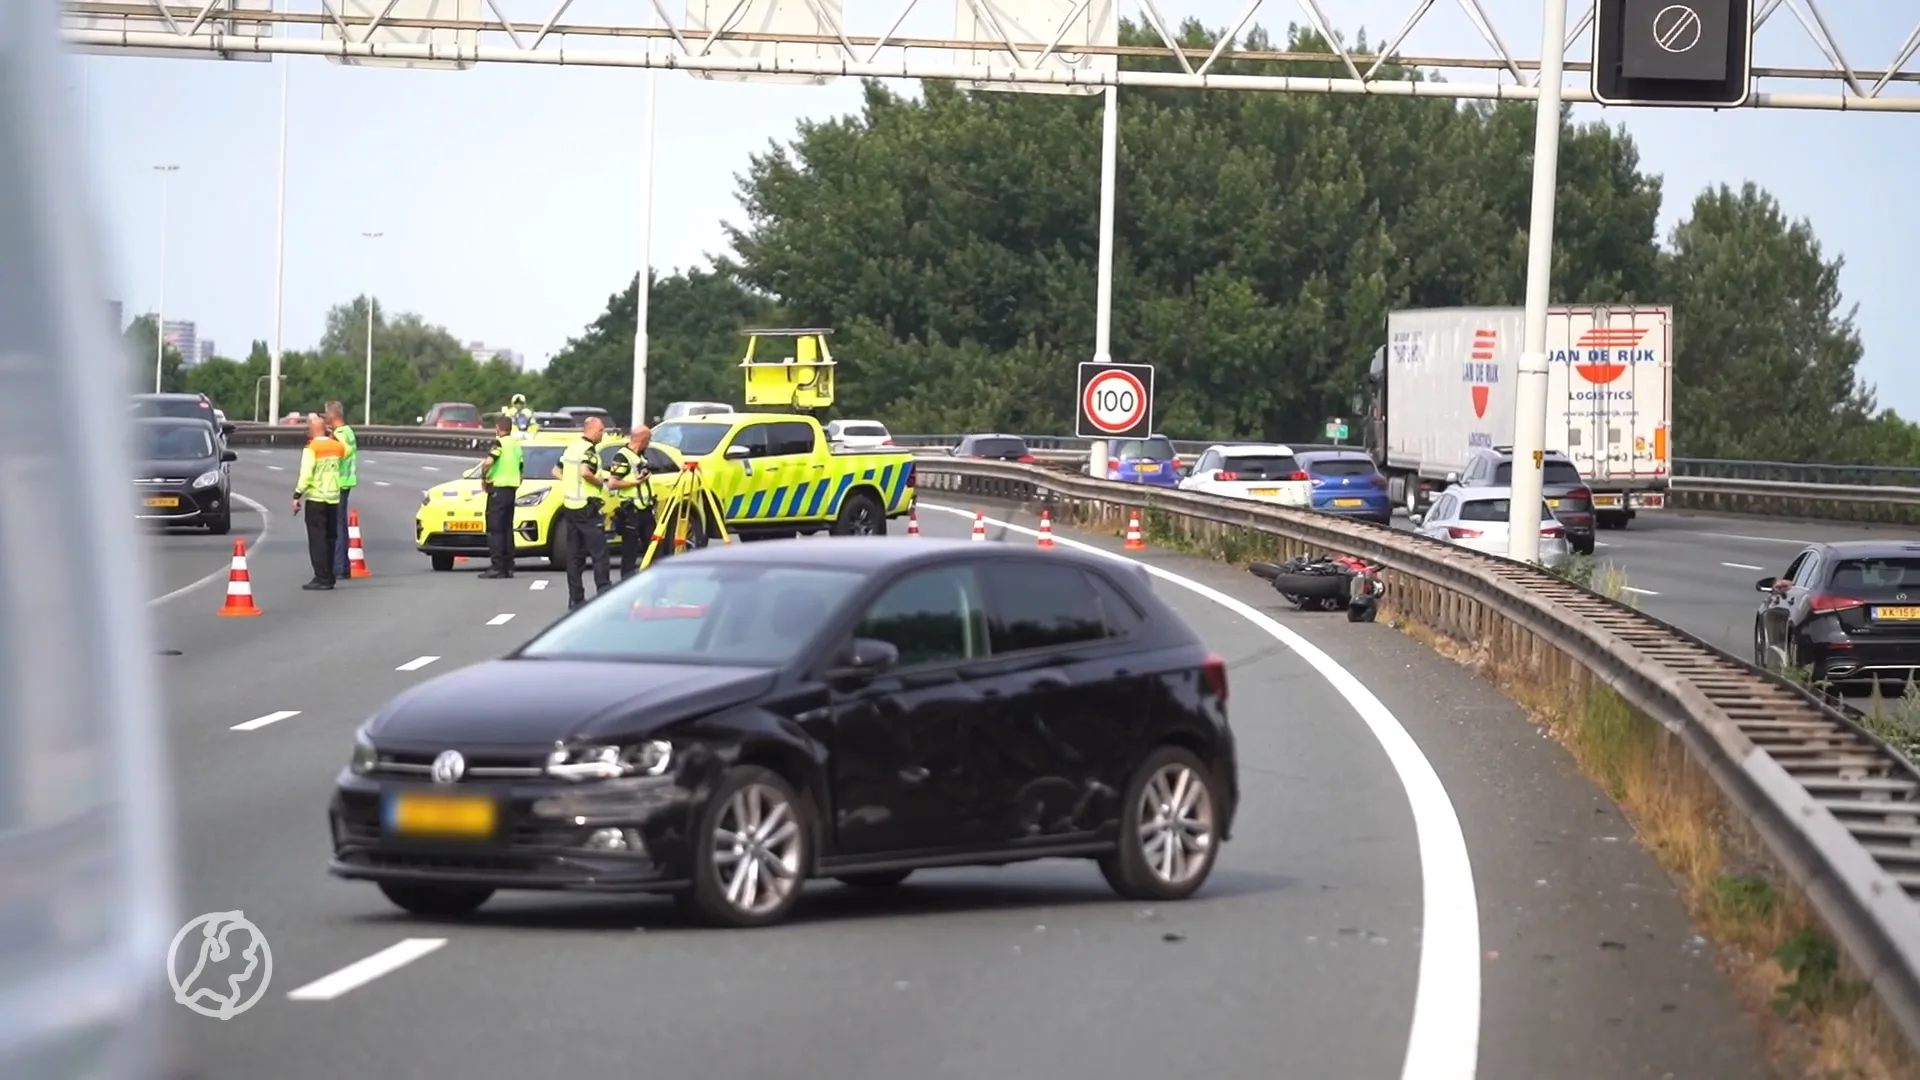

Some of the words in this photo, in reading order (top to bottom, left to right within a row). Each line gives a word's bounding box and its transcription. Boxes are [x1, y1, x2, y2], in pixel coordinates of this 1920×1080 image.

[1548, 350, 1580, 362] JAN
[1588, 350, 1609, 362] DE
[1618, 350, 1655, 362] RIJK
[1097, 390, 1134, 412] 100
[1568, 391, 1633, 400] LOGISTICS
